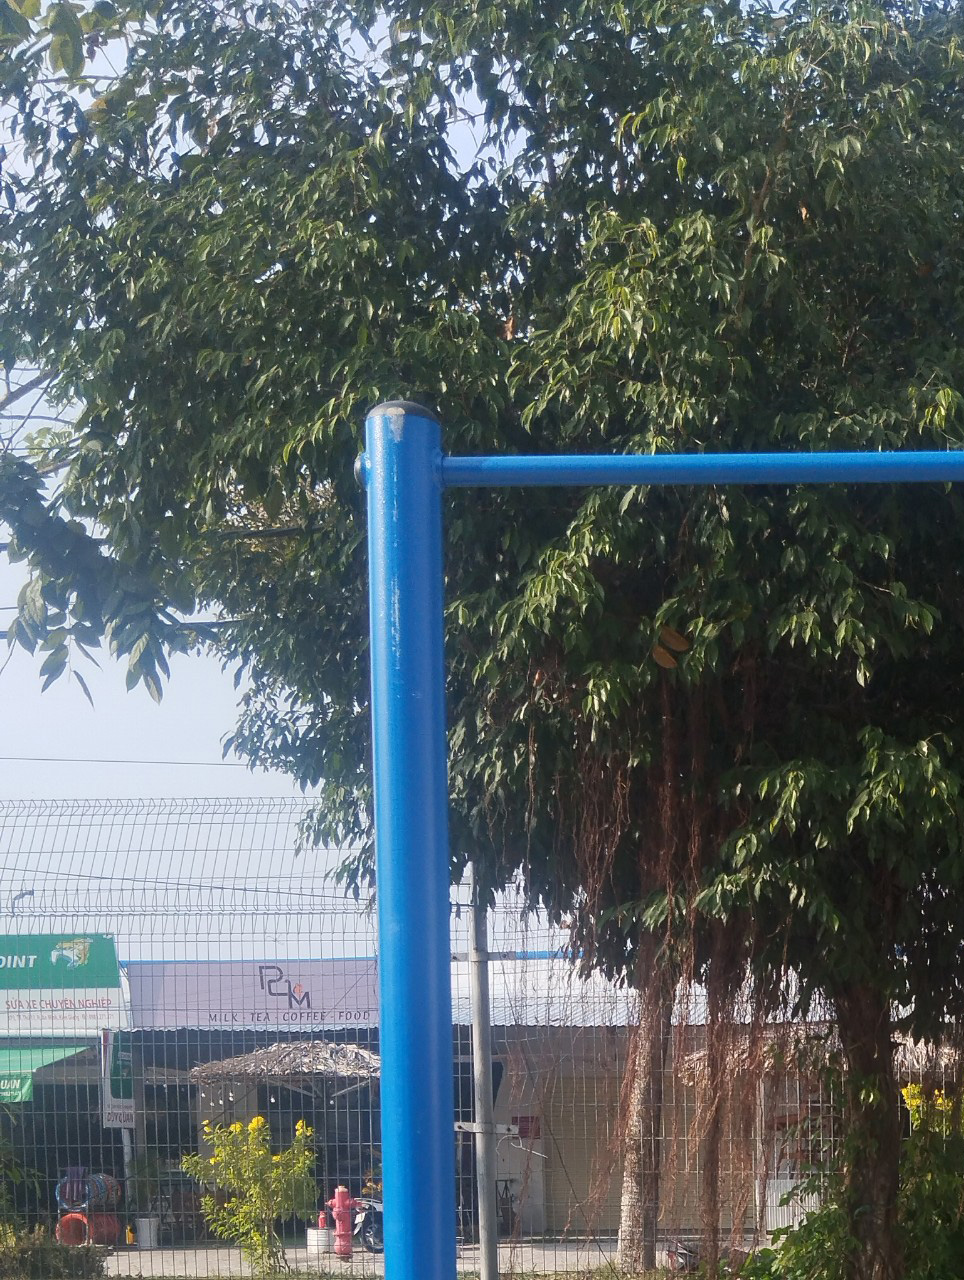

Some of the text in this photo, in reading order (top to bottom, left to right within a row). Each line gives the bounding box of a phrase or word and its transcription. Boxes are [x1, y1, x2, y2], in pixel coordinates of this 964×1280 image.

[26, 1000, 37, 1009] XE
[208, 1012, 238, 1023] MILK
[250, 1012, 271, 1022] TEA
[282, 1011, 326, 1022] COFFEE
[338, 1011, 371, 1021] FOOD
